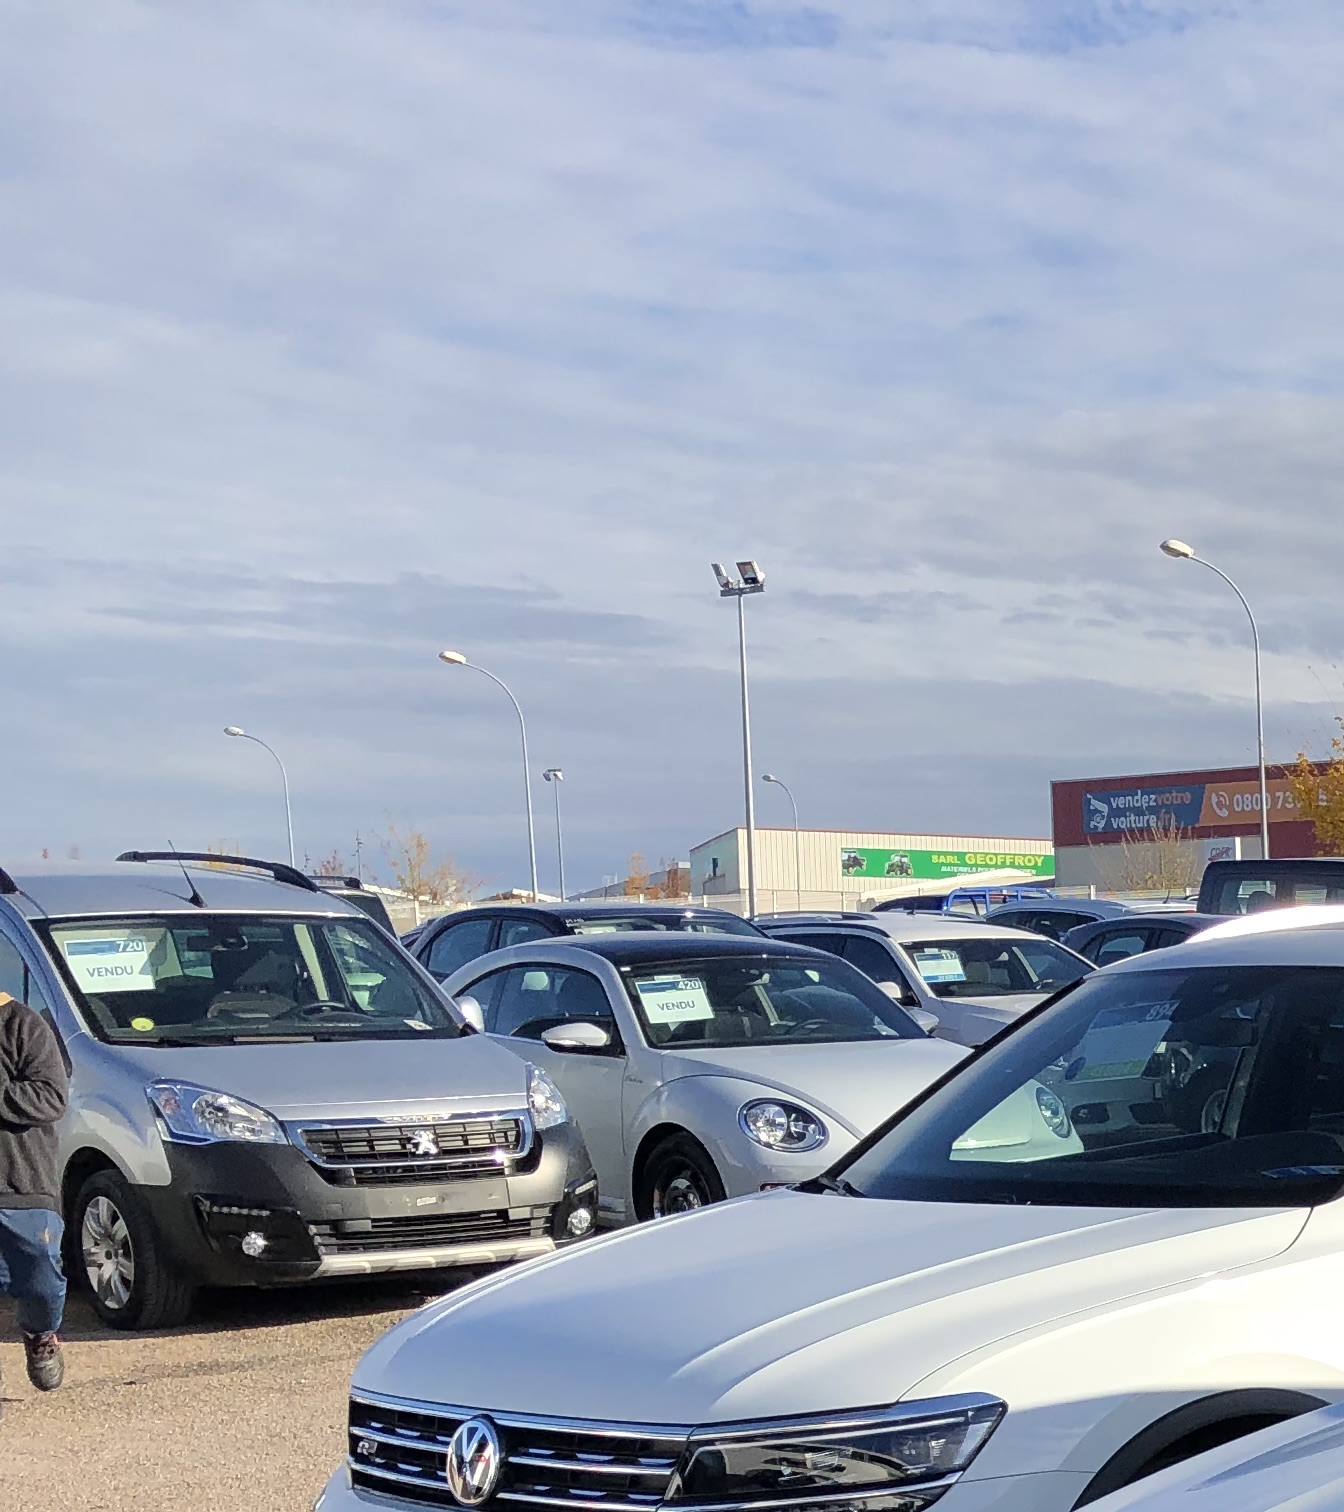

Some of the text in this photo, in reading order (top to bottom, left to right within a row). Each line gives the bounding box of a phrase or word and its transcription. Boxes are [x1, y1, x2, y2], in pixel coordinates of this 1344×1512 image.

[931, 853, 1044, 866] SARL GEOFFROY
[116, 940, 142, 952] 720
[86, 965, 134, 977] VENDU
[678, 980, 699, 990] 420
[657, 1000, 696, 1011] VENDU
